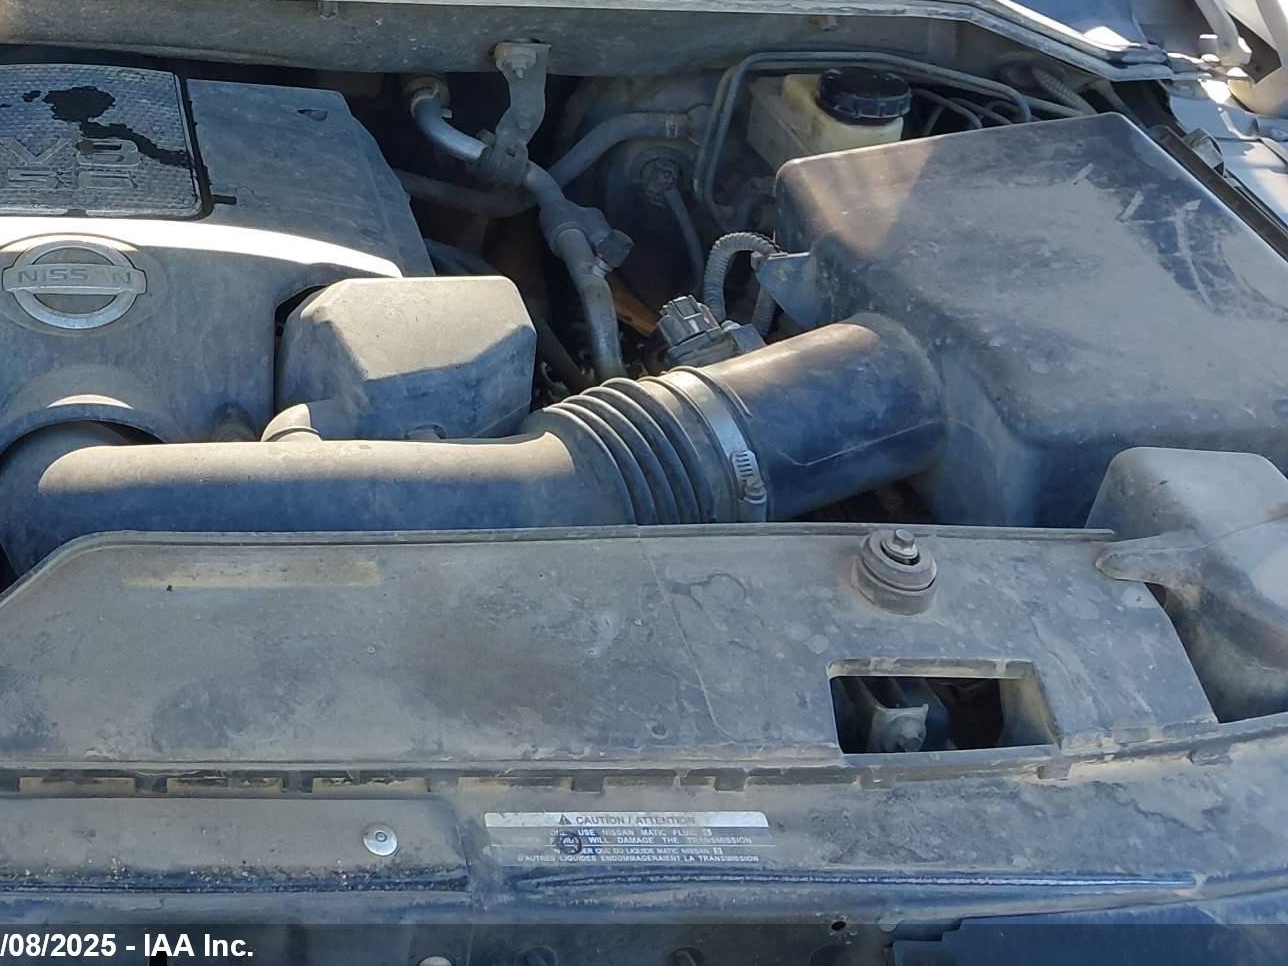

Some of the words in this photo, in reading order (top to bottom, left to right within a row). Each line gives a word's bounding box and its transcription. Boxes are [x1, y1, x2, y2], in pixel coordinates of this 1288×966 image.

[19, 268, 131, 284] NISSN
[575, 816, 625, 825] CAUTION
[635, 816, 696, 825] ATTENTION
[601, 828, 635, 836] NISSAN
[687, 836, 753, 845] TRANSMISSION
[559, 855, 598, 863] LIQUIDES
[697, 855, 760, 863] TRANSMISSION
